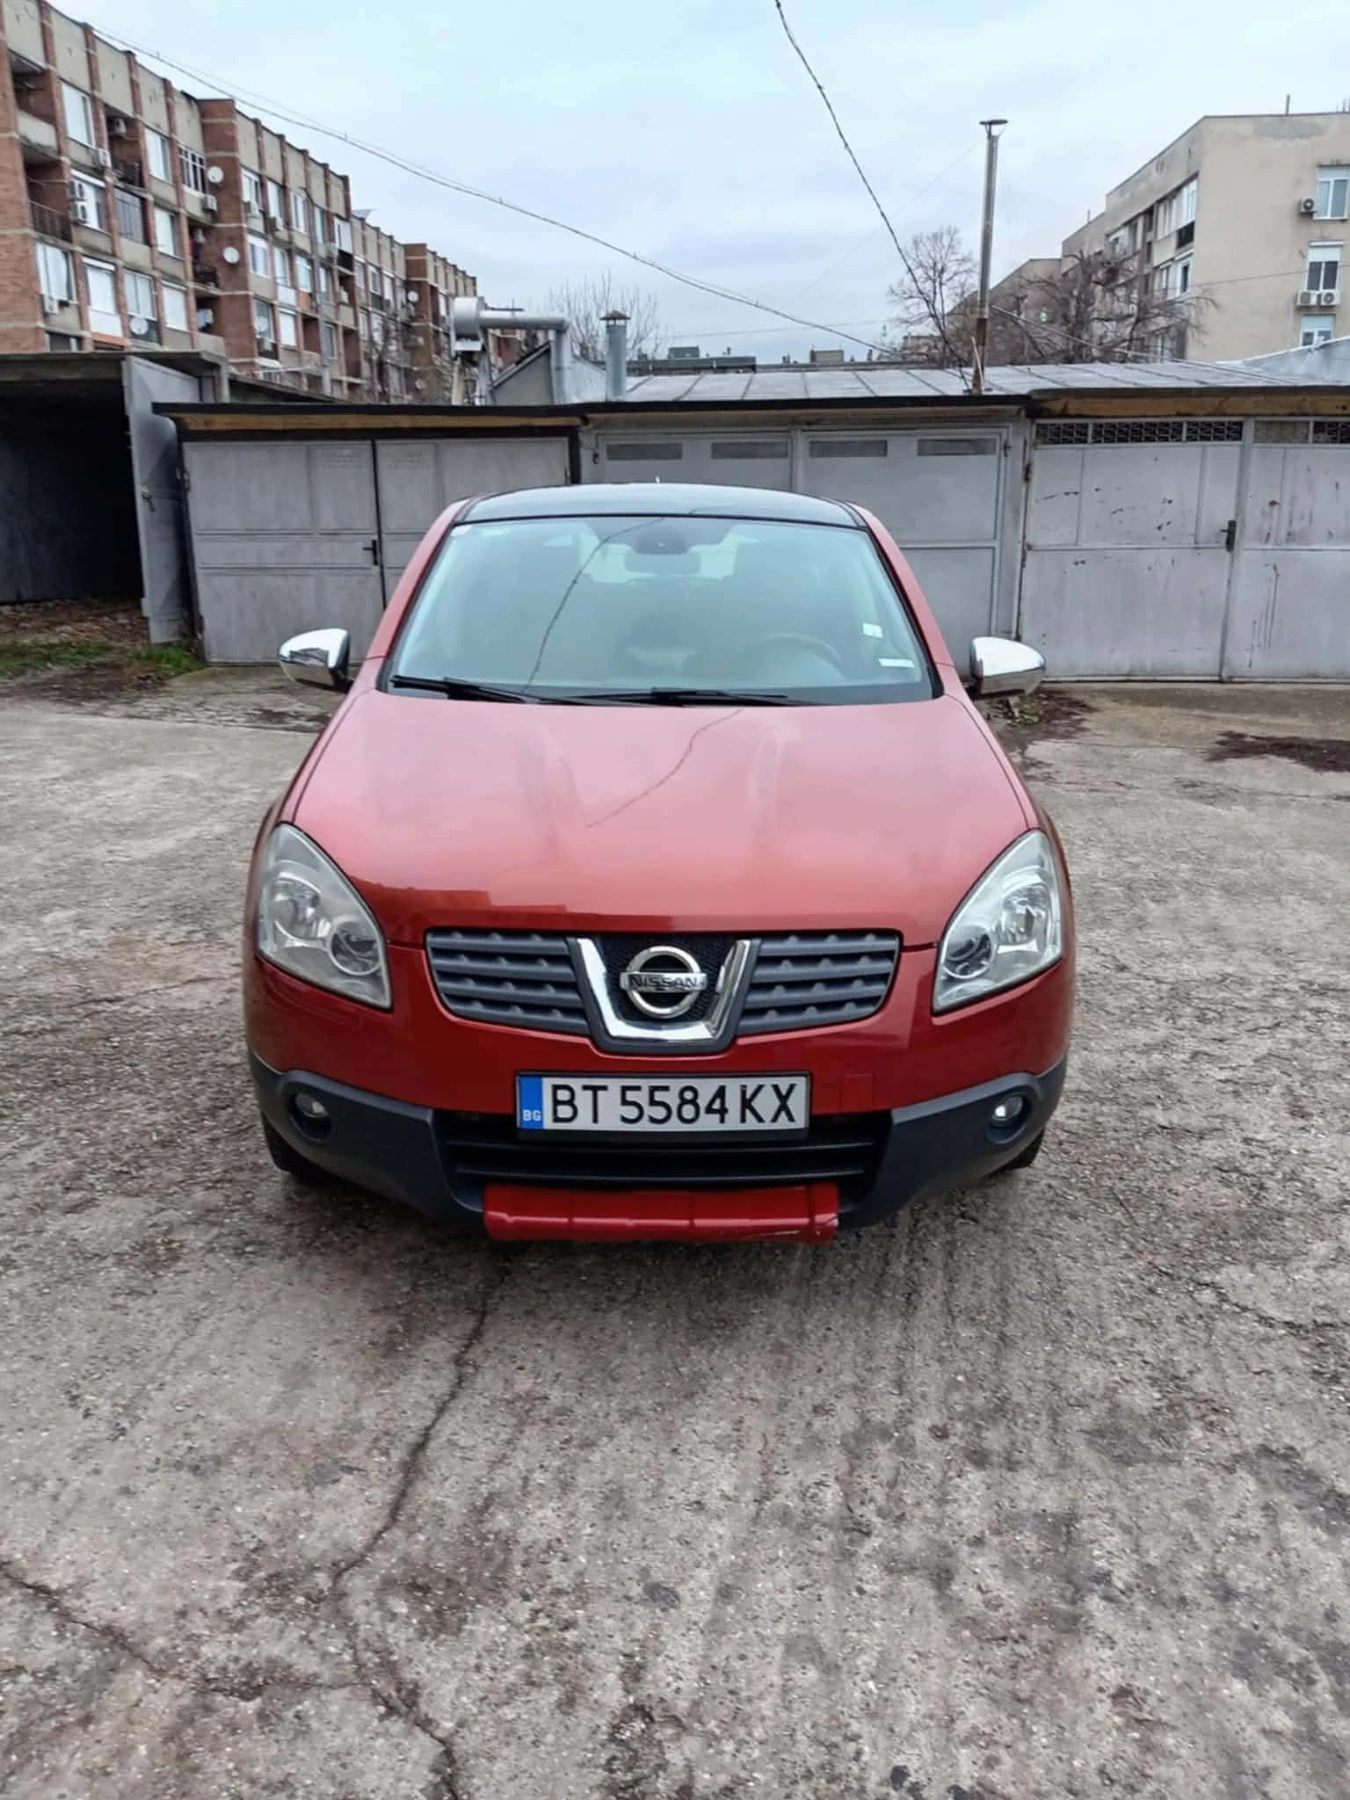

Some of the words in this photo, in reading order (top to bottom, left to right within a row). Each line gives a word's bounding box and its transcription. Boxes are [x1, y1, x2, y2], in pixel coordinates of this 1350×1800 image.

[629, 976, 697, 991] NISSAN
[551, 1084, 608, 1124] BT
[620, 1084, 729, 1125] 5584
[740, 1083, 797, 1124] KX
[522, 1110, 542, 1122] BG
